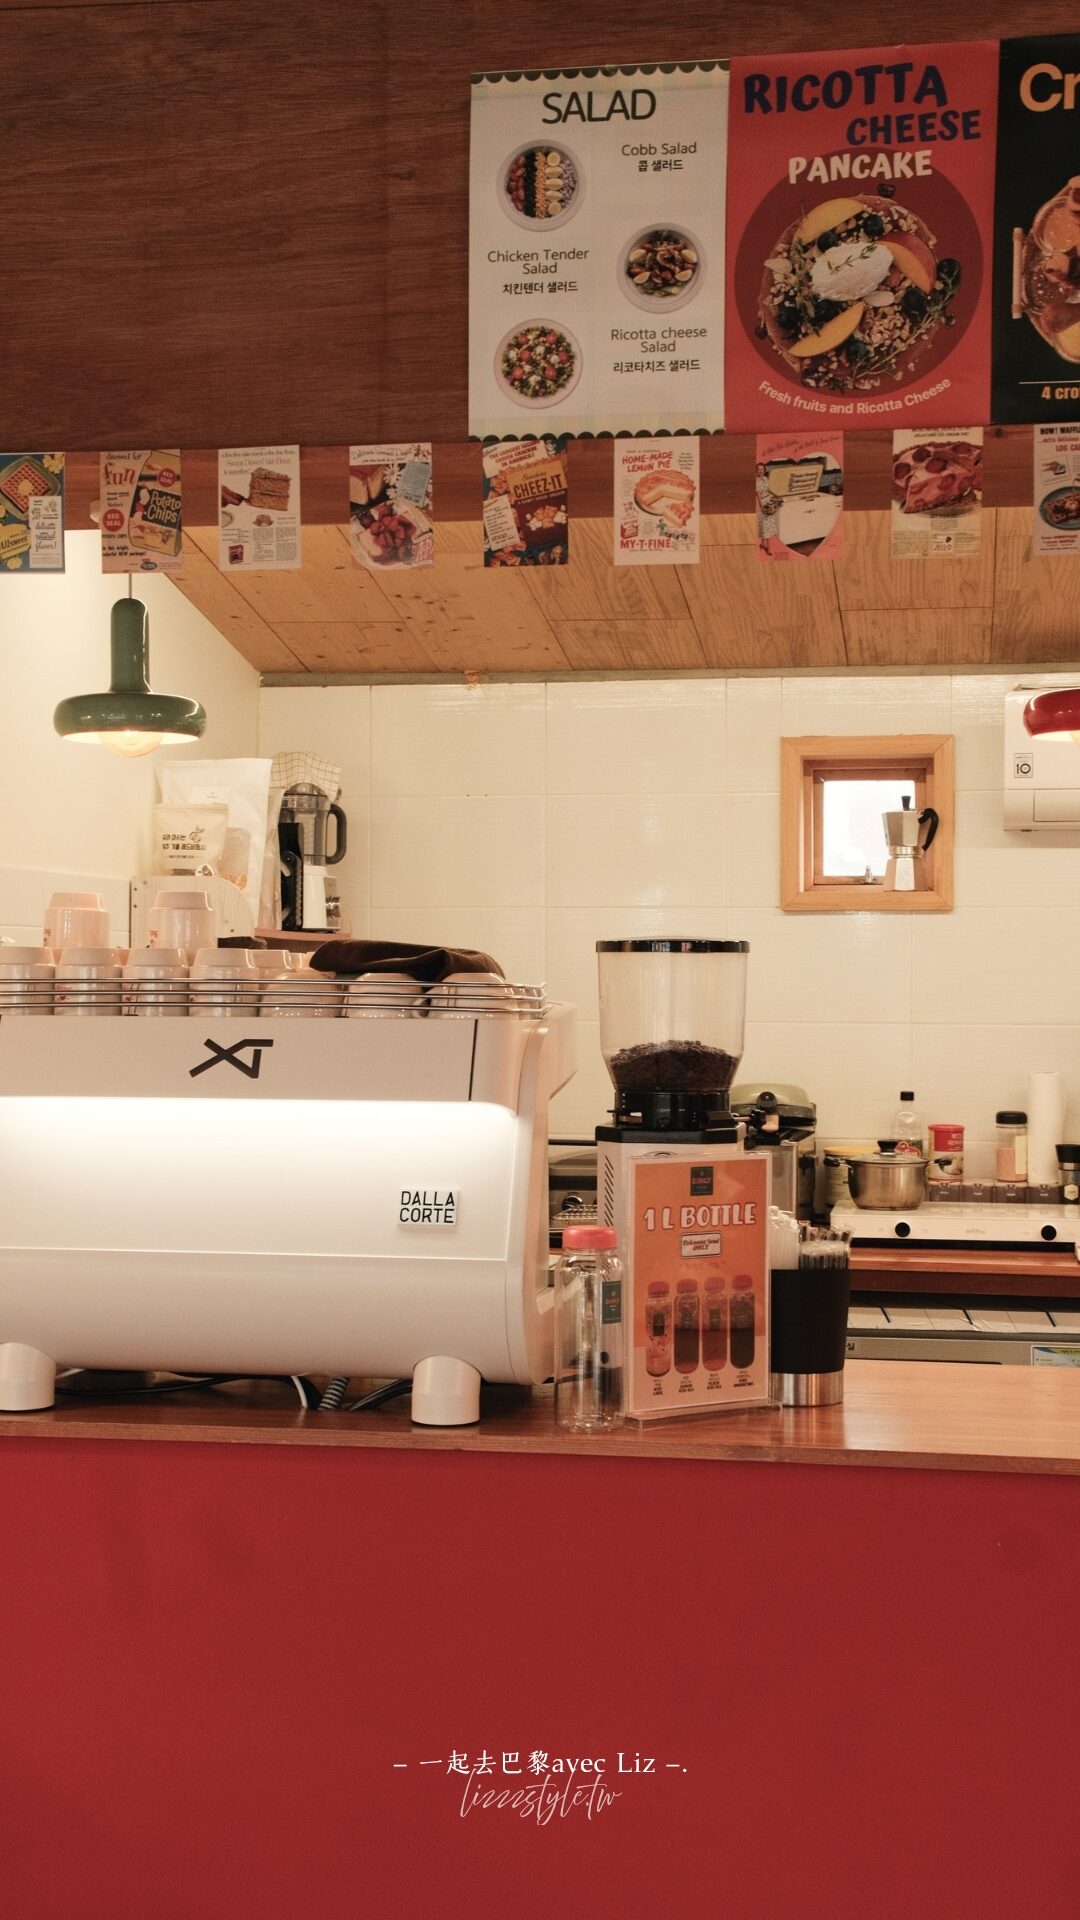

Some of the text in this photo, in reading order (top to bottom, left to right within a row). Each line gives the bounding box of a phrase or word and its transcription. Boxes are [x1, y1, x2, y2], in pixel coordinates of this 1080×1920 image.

[744, 62, 948, 114] RICOTTA
[542, 88, 656, 124] SALAD
[846, 110, 981, 146] CHEESE
[621, 141, 697, 156] Cobb Salad
[651, 159, 684, 172] 샐러드
[789, 149, 933, 185] PANCAKE
[487, 248, 589, 262] Chicken Tender
[523, 262, 557, 274] Salad
[503, 281, 578, 295] 치킨텐더 샐러드
[611, 326, 707, 340] Ricotta cheese
[640, 340, 676, 353] Salad
[613, 359, 701, 373] 리코타치즈 샐러드
[758, 378, 951, 414] Fresh fruits and Ricotta Cheese
[1041, 386, 1080, 400] 4 cro
[658, 460, 671, 469] PIE
[104, 462, 136, 485] fun
[514, 474, 562, 498] CHEEZ-IT
[151, 491, 181, 511] Potato
[147, 504, 178, 523] Chips
[401, 1190, 455, 1207] DALLA
[400, 1207, 455, 1224] CORTE
[643, 1203, 757, 1231] 1 L BOTTLE
